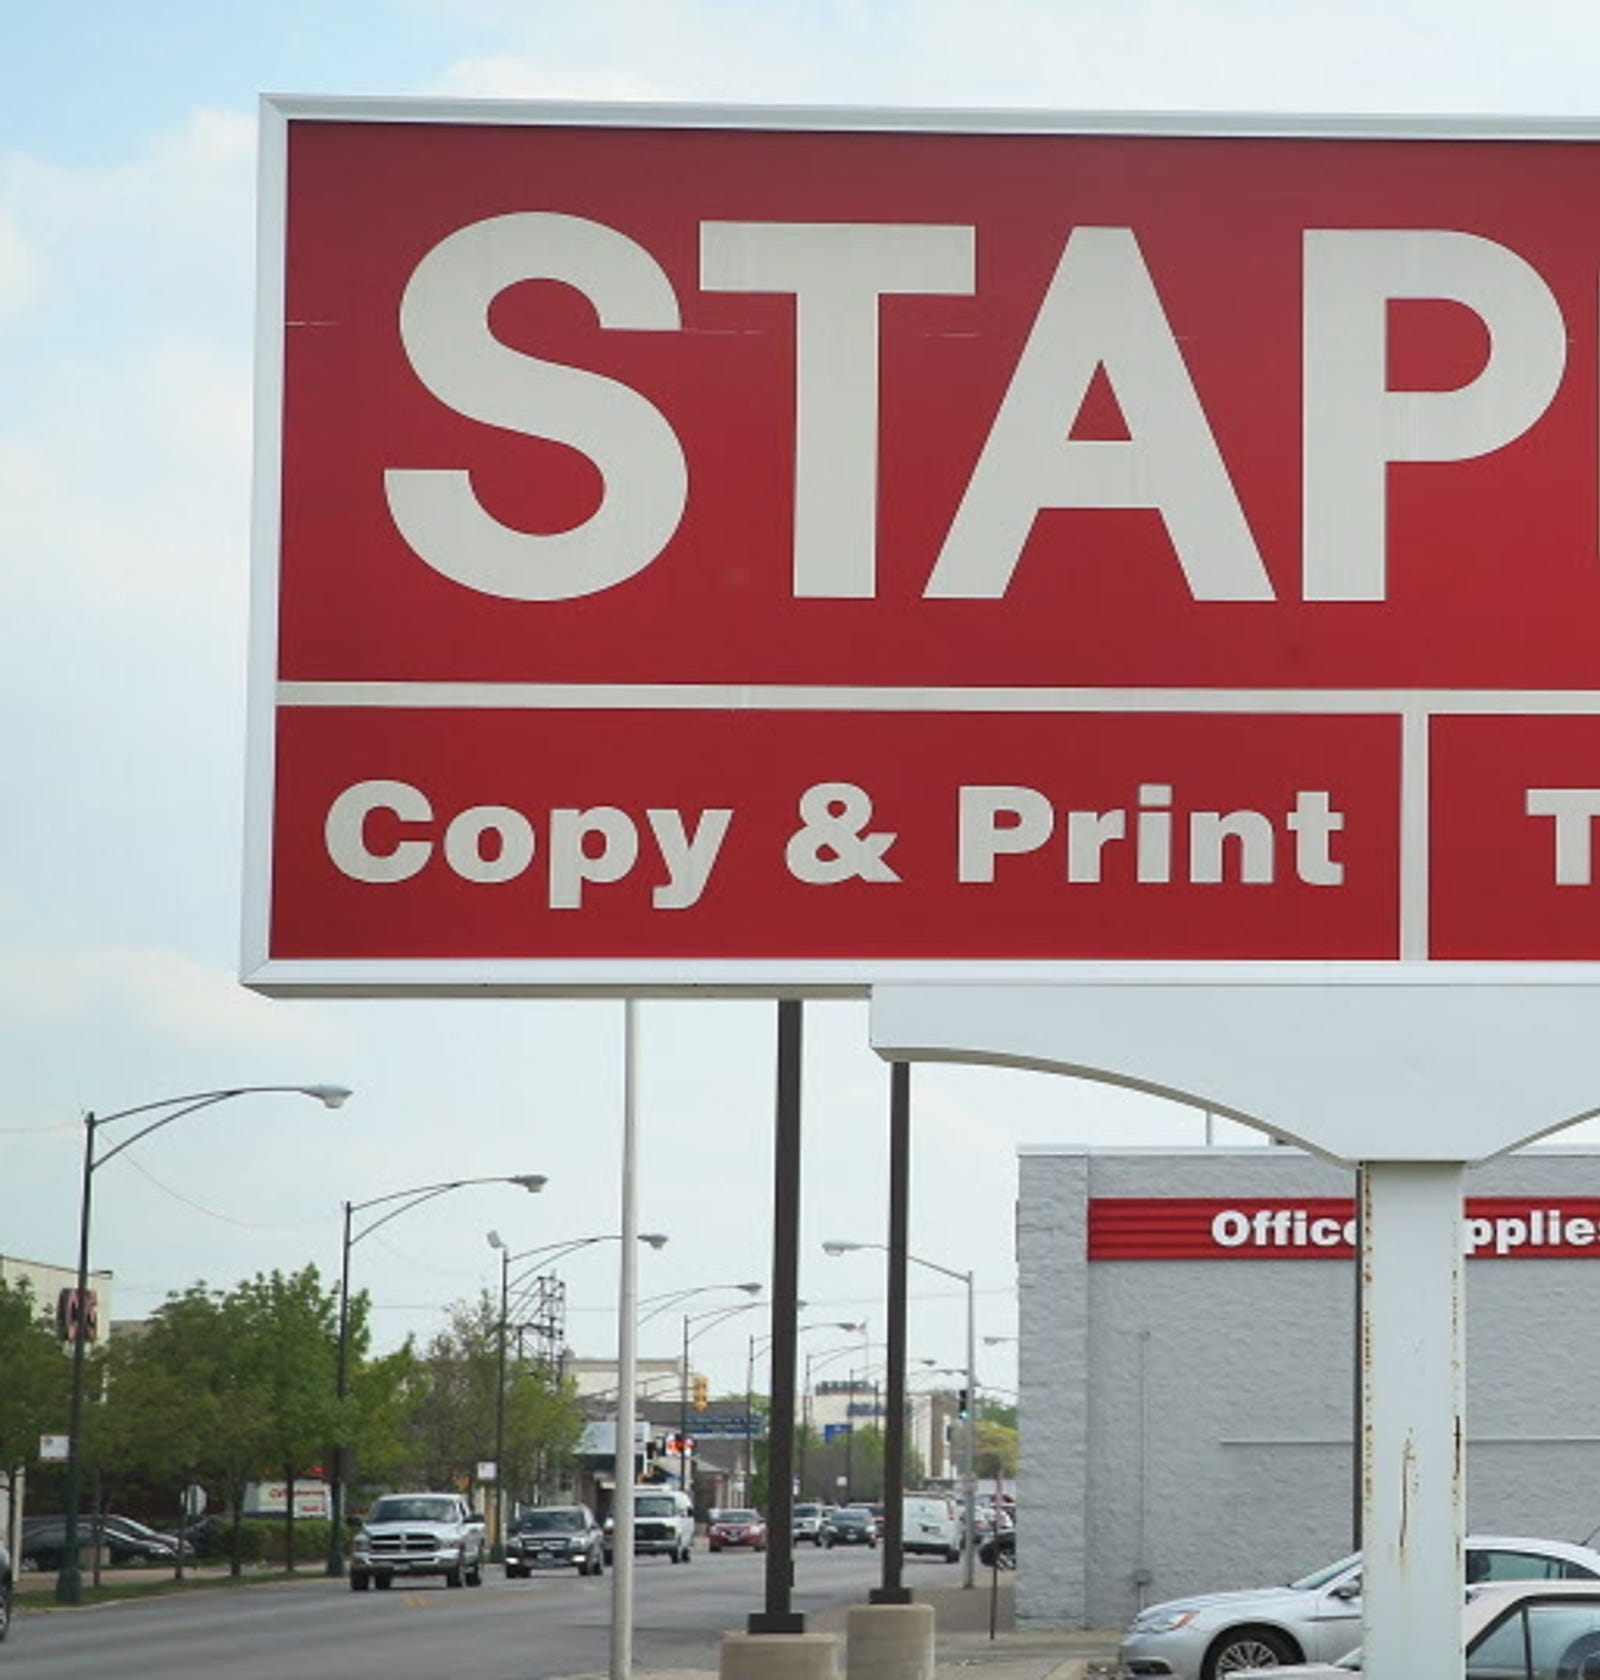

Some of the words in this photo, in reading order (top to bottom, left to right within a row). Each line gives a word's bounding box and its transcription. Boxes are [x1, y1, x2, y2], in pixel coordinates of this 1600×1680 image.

[325, 780, 733, 908] Copy
[786, 783, 901, 884] &
[959, 784, 1343, 885] Print
